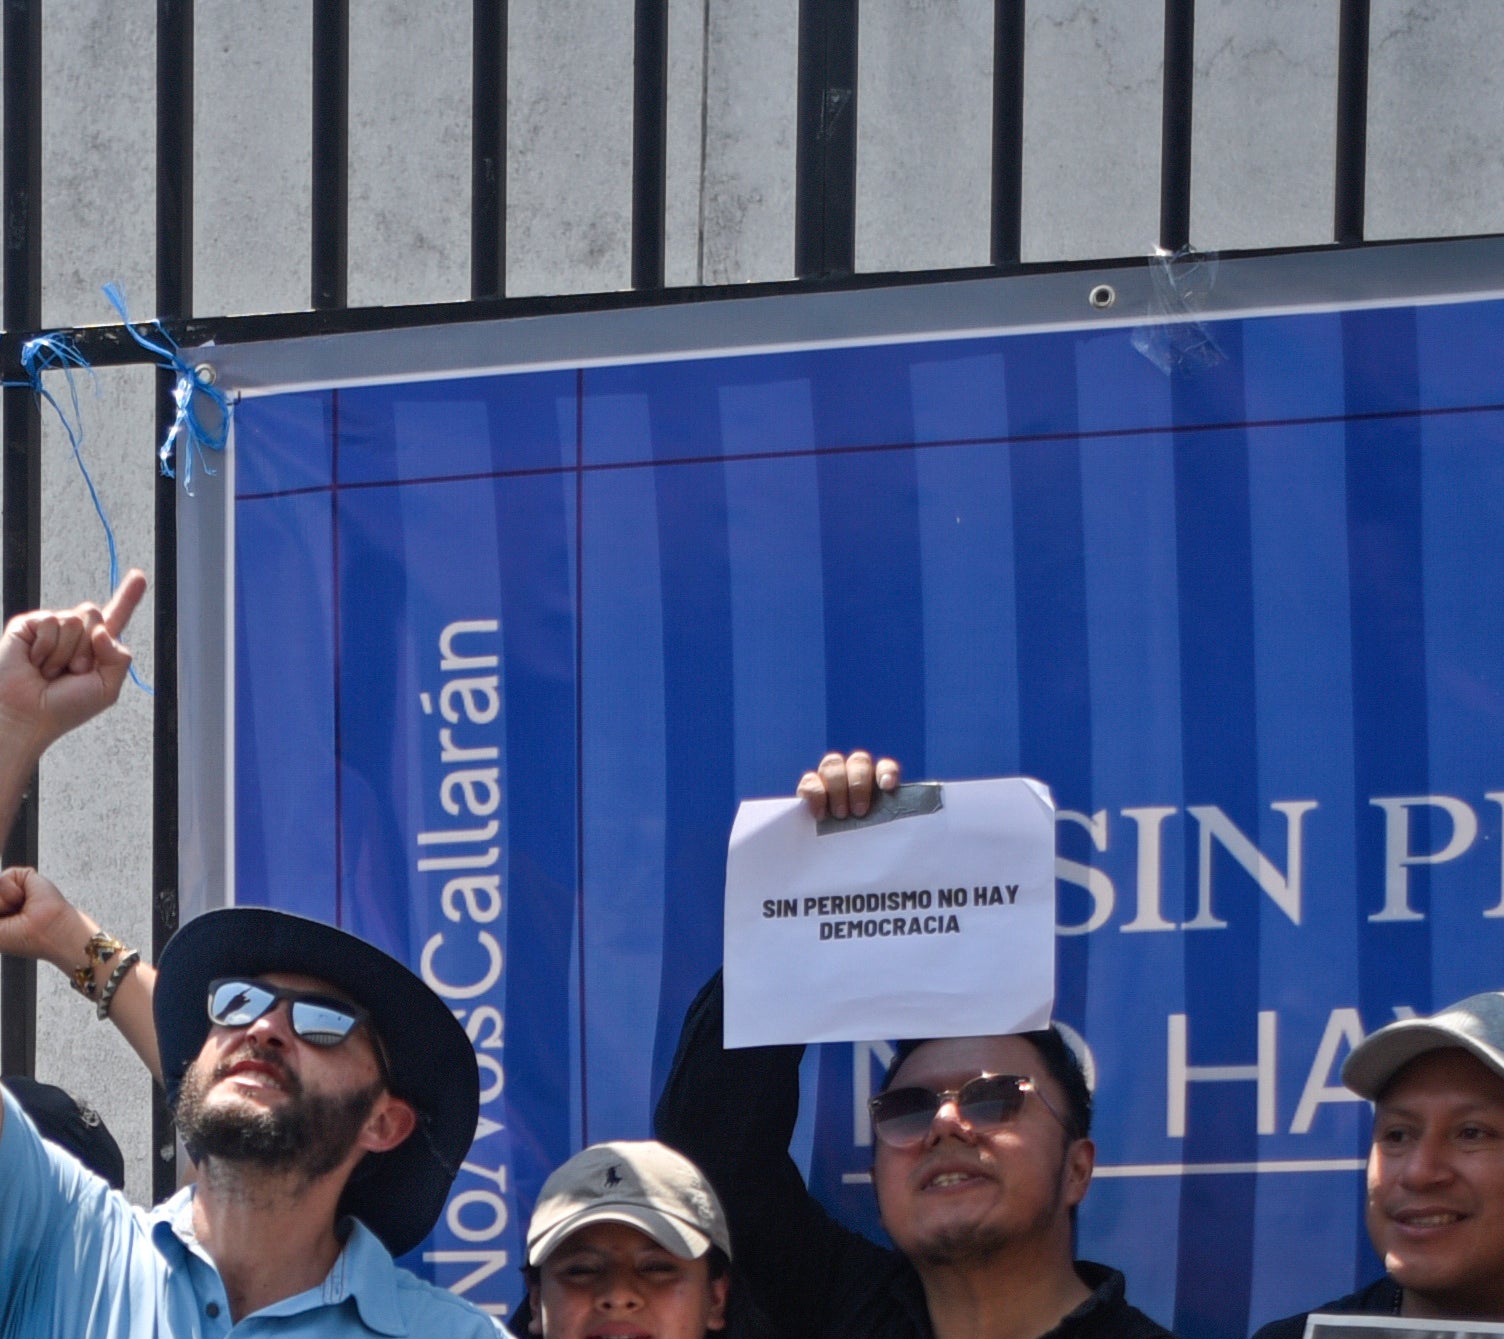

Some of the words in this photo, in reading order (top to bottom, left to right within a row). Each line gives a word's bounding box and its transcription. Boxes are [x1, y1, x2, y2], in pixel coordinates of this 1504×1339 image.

[1055, 801, 1318, 936] SIN
[762, 898, 798, 919] SIN
[803, 890, 933, 918] PERIODISMO
[937, 888, 968, 911] NO
[974, 884, 1019, 908] HAY
[819, 915, 960, 941] DEMOCRACIA
